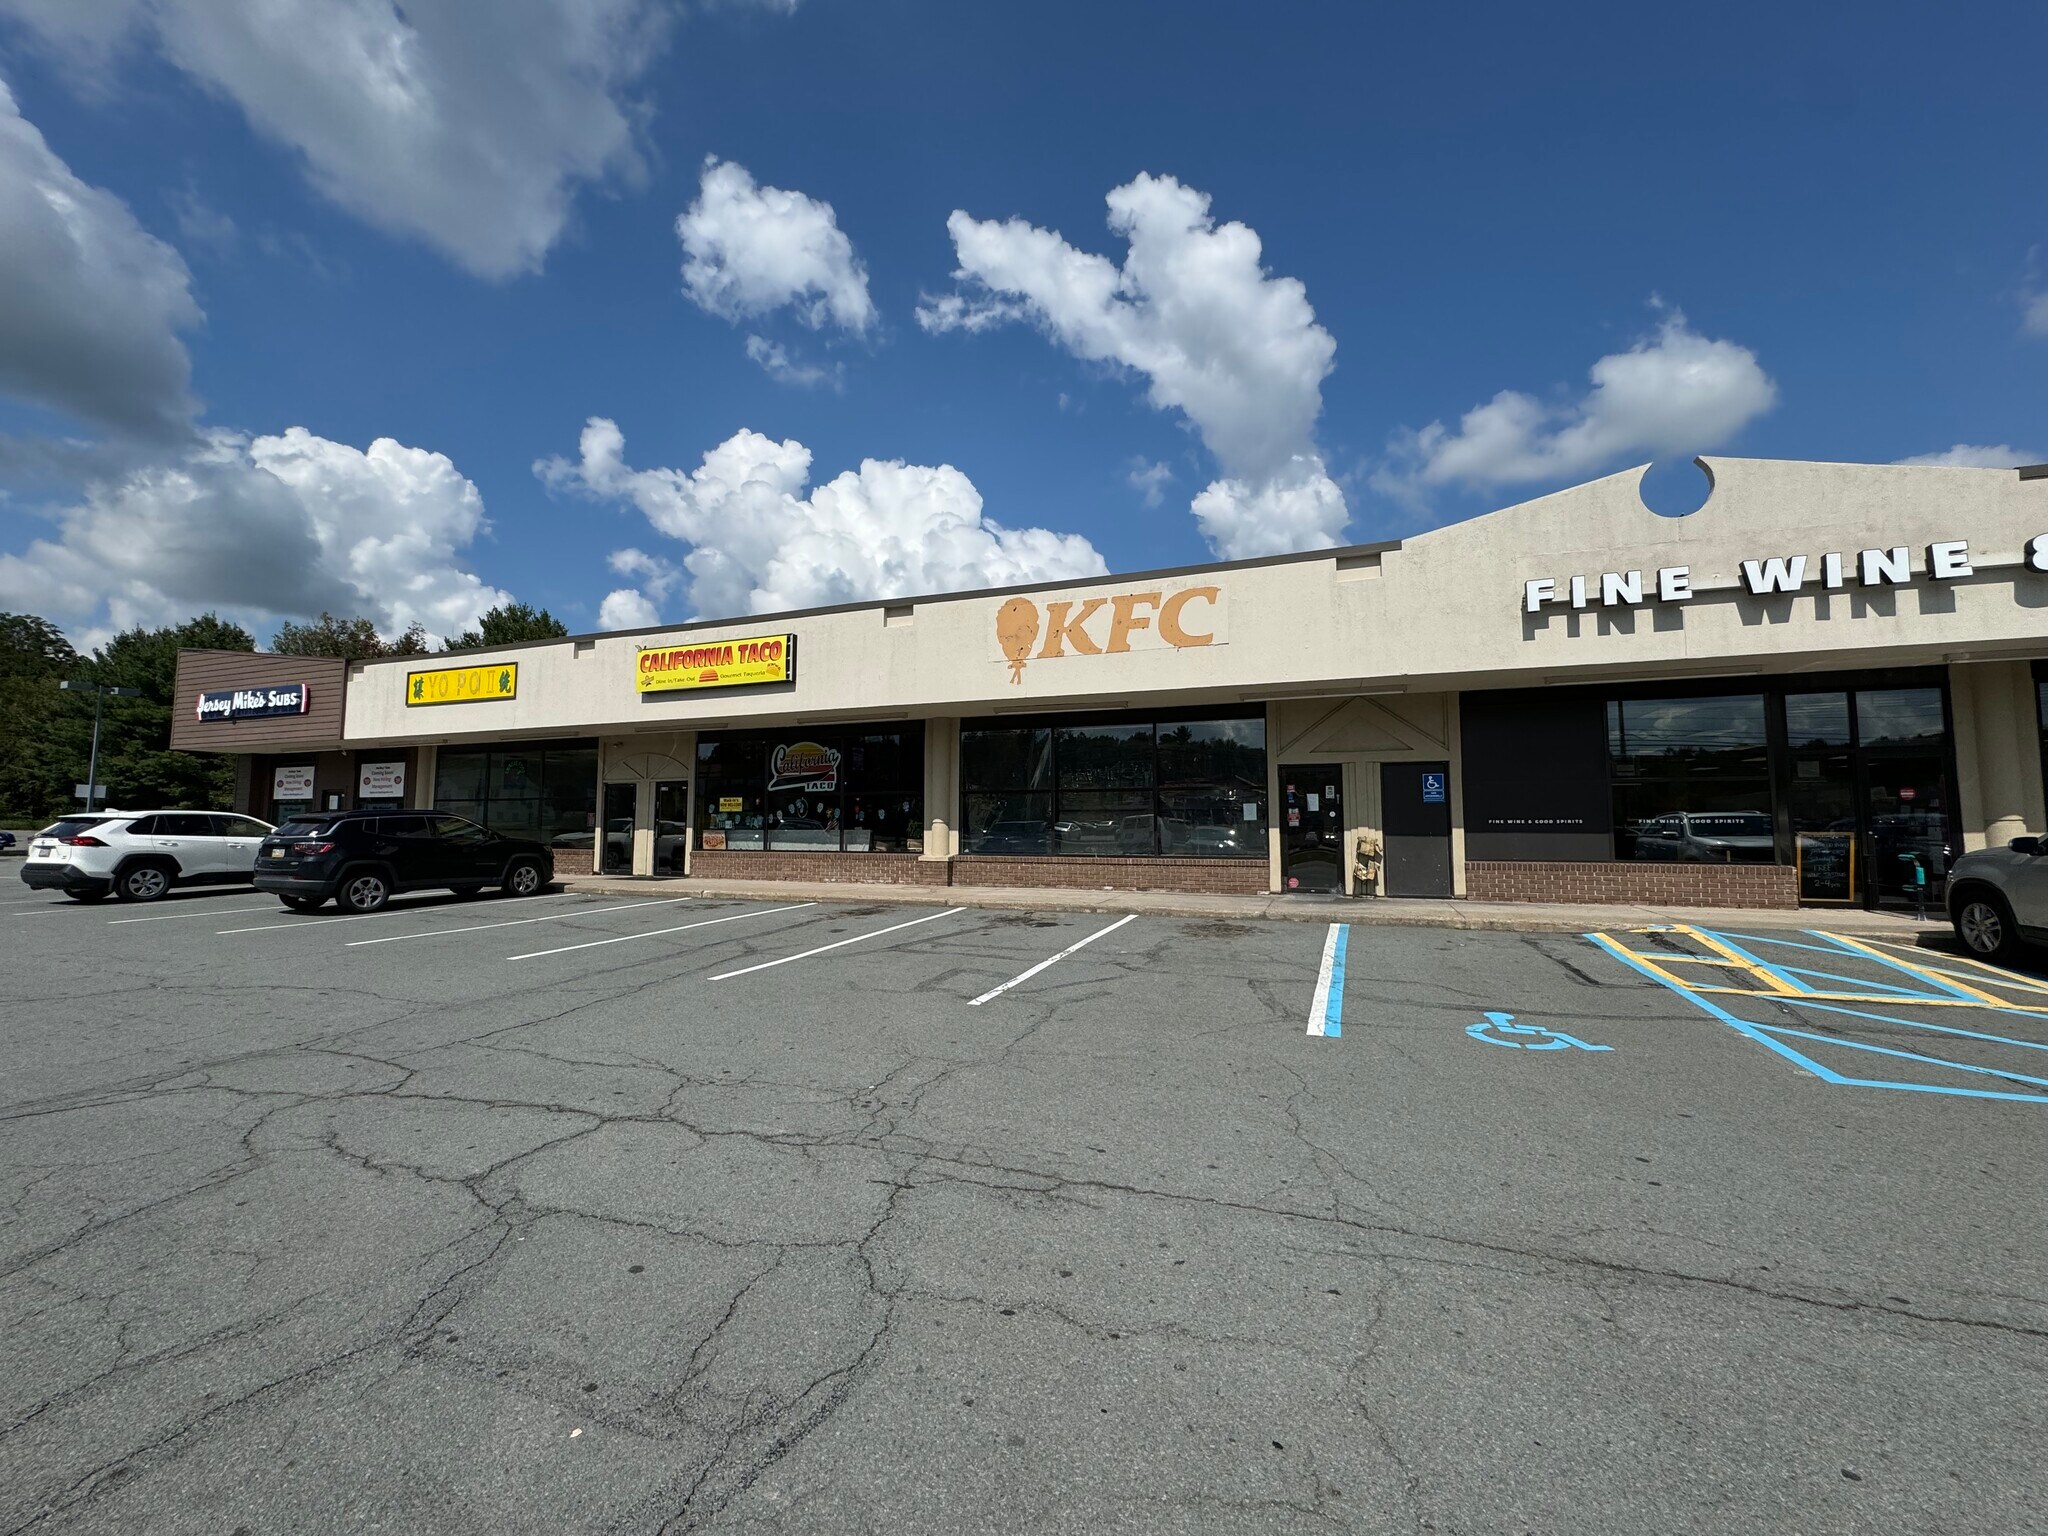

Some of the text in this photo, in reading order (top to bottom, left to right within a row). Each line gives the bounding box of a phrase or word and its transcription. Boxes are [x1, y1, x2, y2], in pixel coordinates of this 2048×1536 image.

[1525, 565, 1693, 612] FINE
[1741, 539, 1974, 594] WINE
[1036, 586, 1222, 659] KFC
[640, 640, 782, 673] CALIFORNIA TACO
[743, 670, 766, 678] Taqueria
[197, 695, 232, 716] Jersey
[232, 691, 267, 710] Mike's
[771, 745, 840, 776] California
[805, 780, 834, 790] TACO
